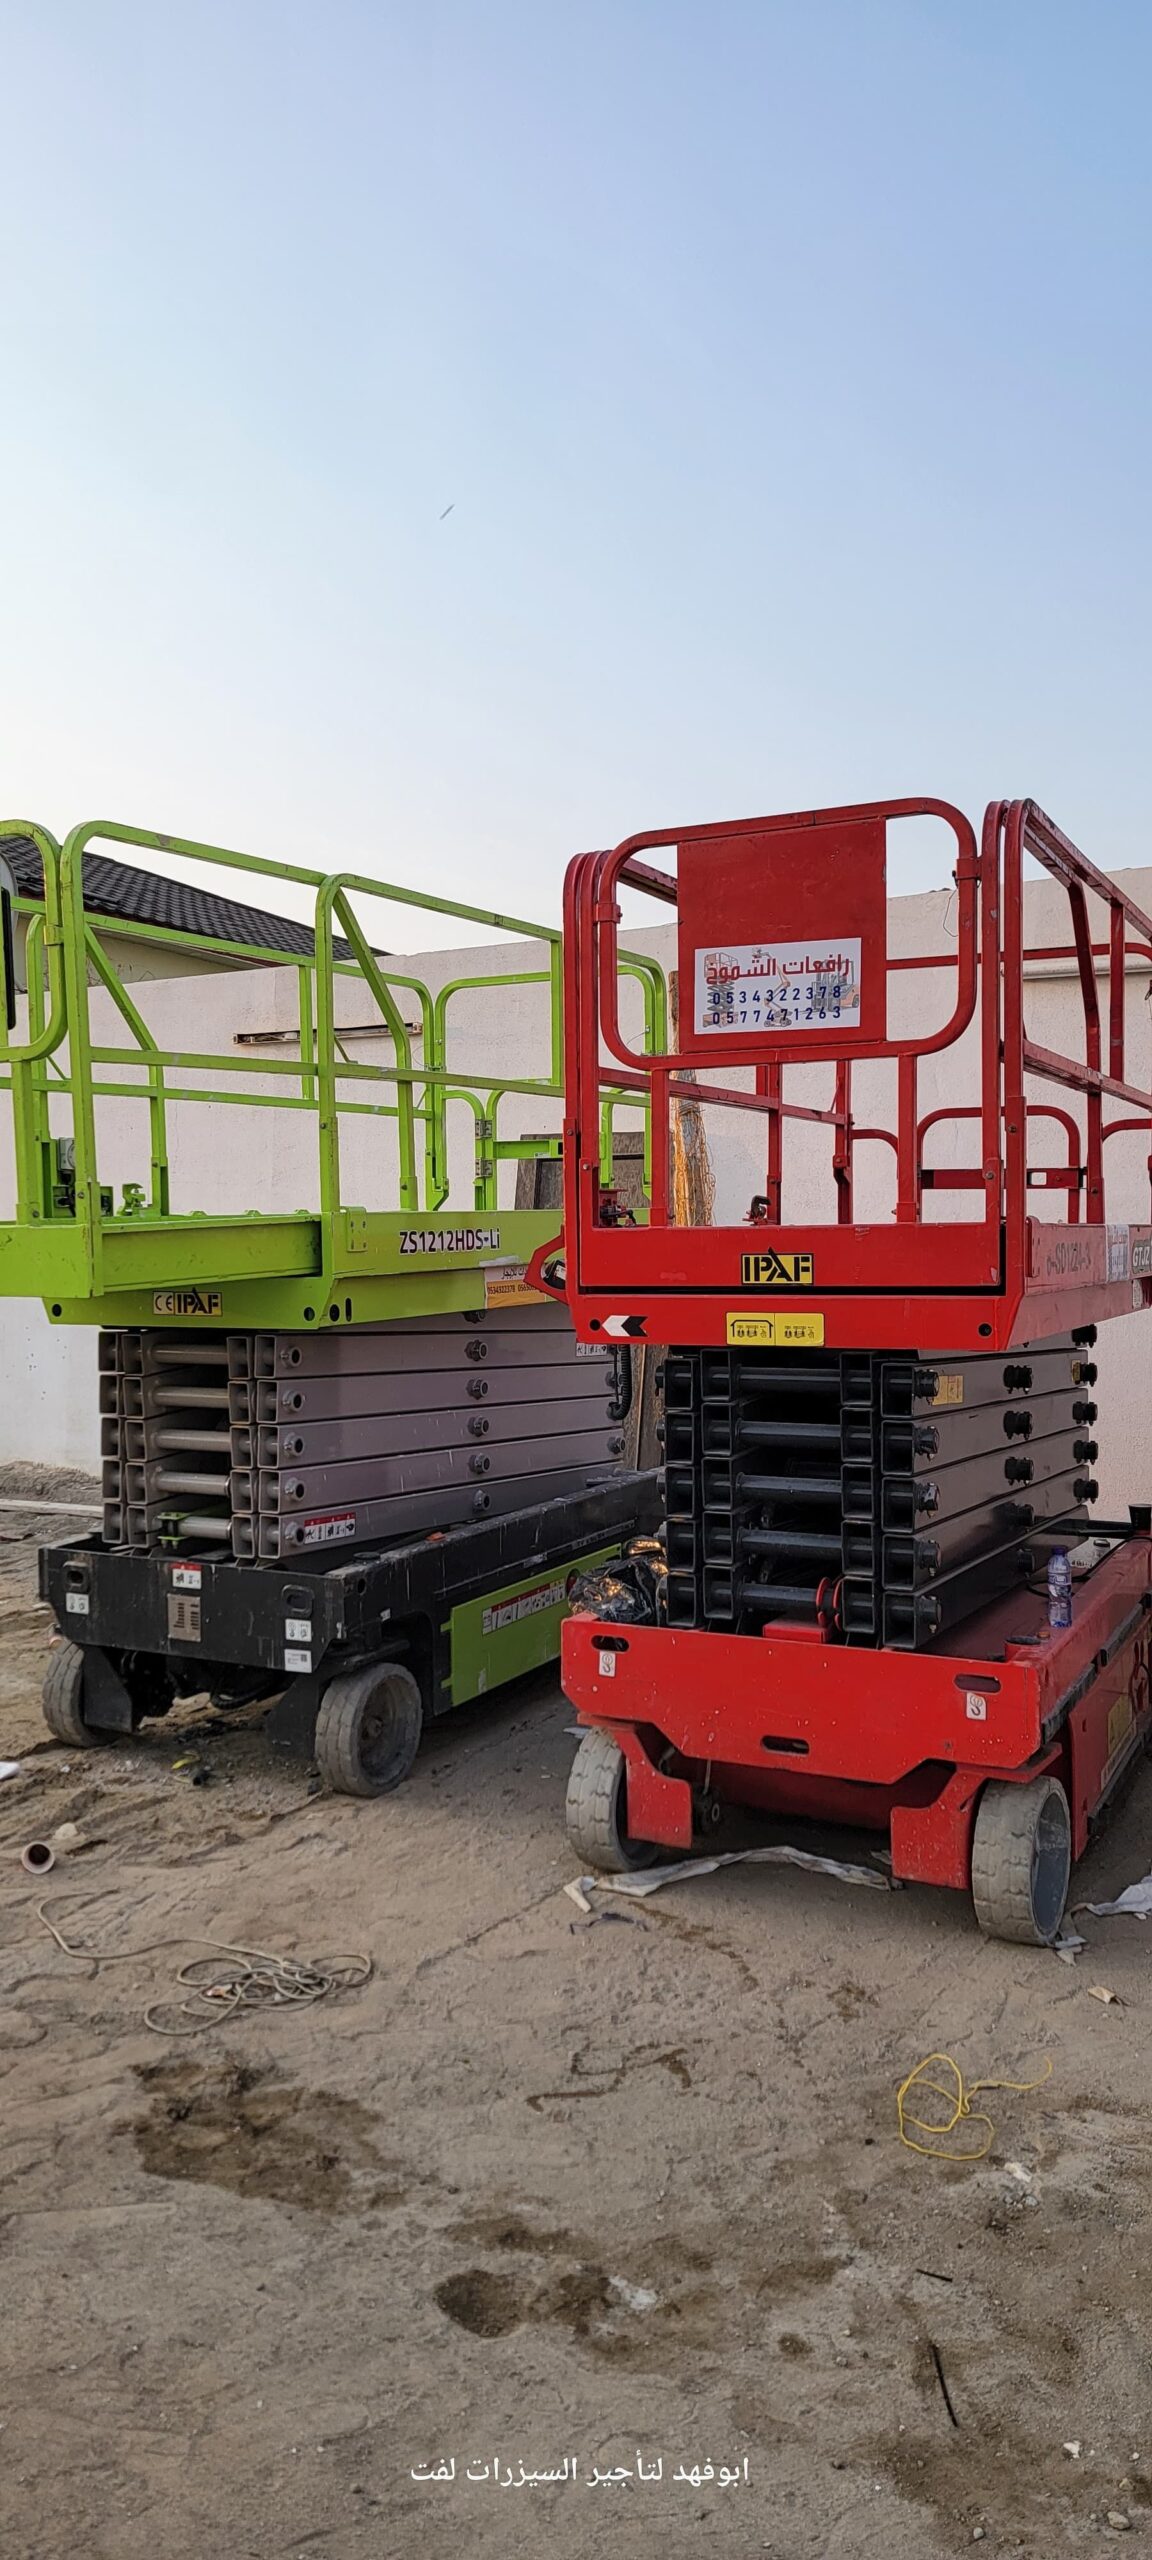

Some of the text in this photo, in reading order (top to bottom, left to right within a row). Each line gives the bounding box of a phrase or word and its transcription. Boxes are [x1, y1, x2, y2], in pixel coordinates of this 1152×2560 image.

[706, 953, 850, 985] رافعات الشموخ
[712, 985, 842, 1005] 0534322378
[712, 1006, 841, 1025] 0577471263
[399, 1228, 500, 1254] ZS1212HDS-Li
[744, 1247, 811, 1282] IPAF
[176, 1287, 219, 1314] IPAF
